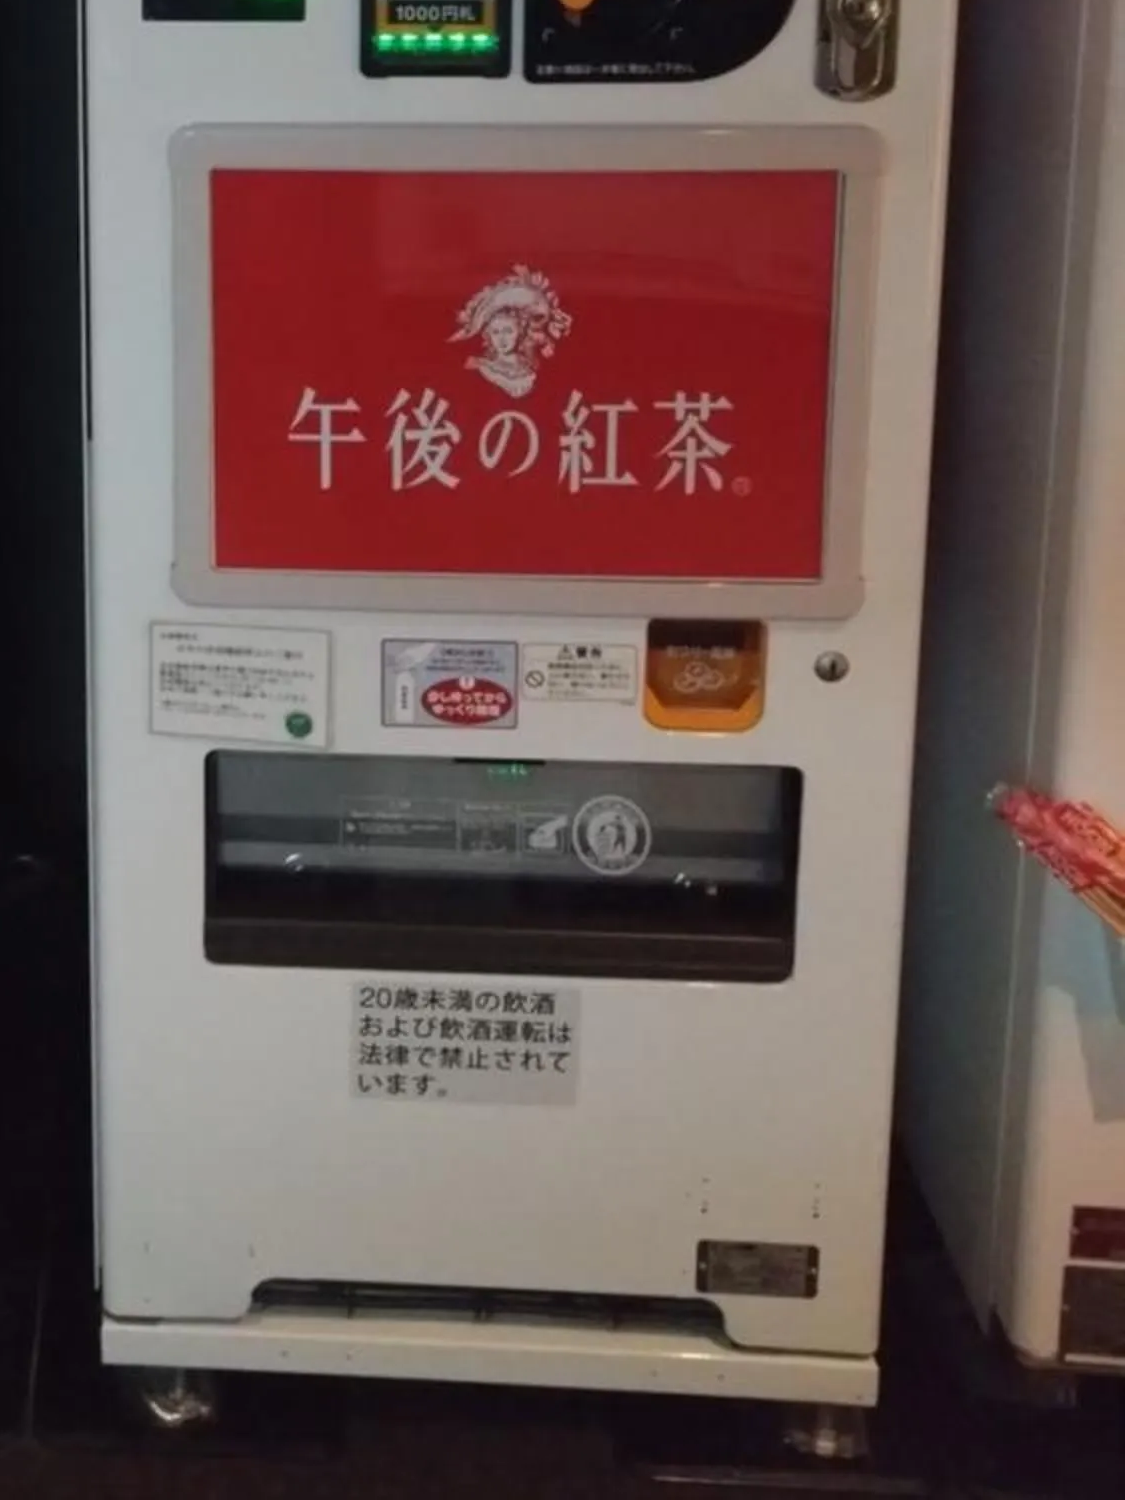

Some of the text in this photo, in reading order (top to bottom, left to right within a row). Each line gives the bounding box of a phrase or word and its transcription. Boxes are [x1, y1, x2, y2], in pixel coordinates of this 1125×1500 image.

[287, 386, 735, 496] 午後の紅茶
[359, 986, 556, 1015] 20歳未満の飲酒
[359, 1015, 573, 1044] および飲酒運転は
[358, 1042, 572, 1073] 法律で禁止されて
[357, 1073, 448, 1097] います。
